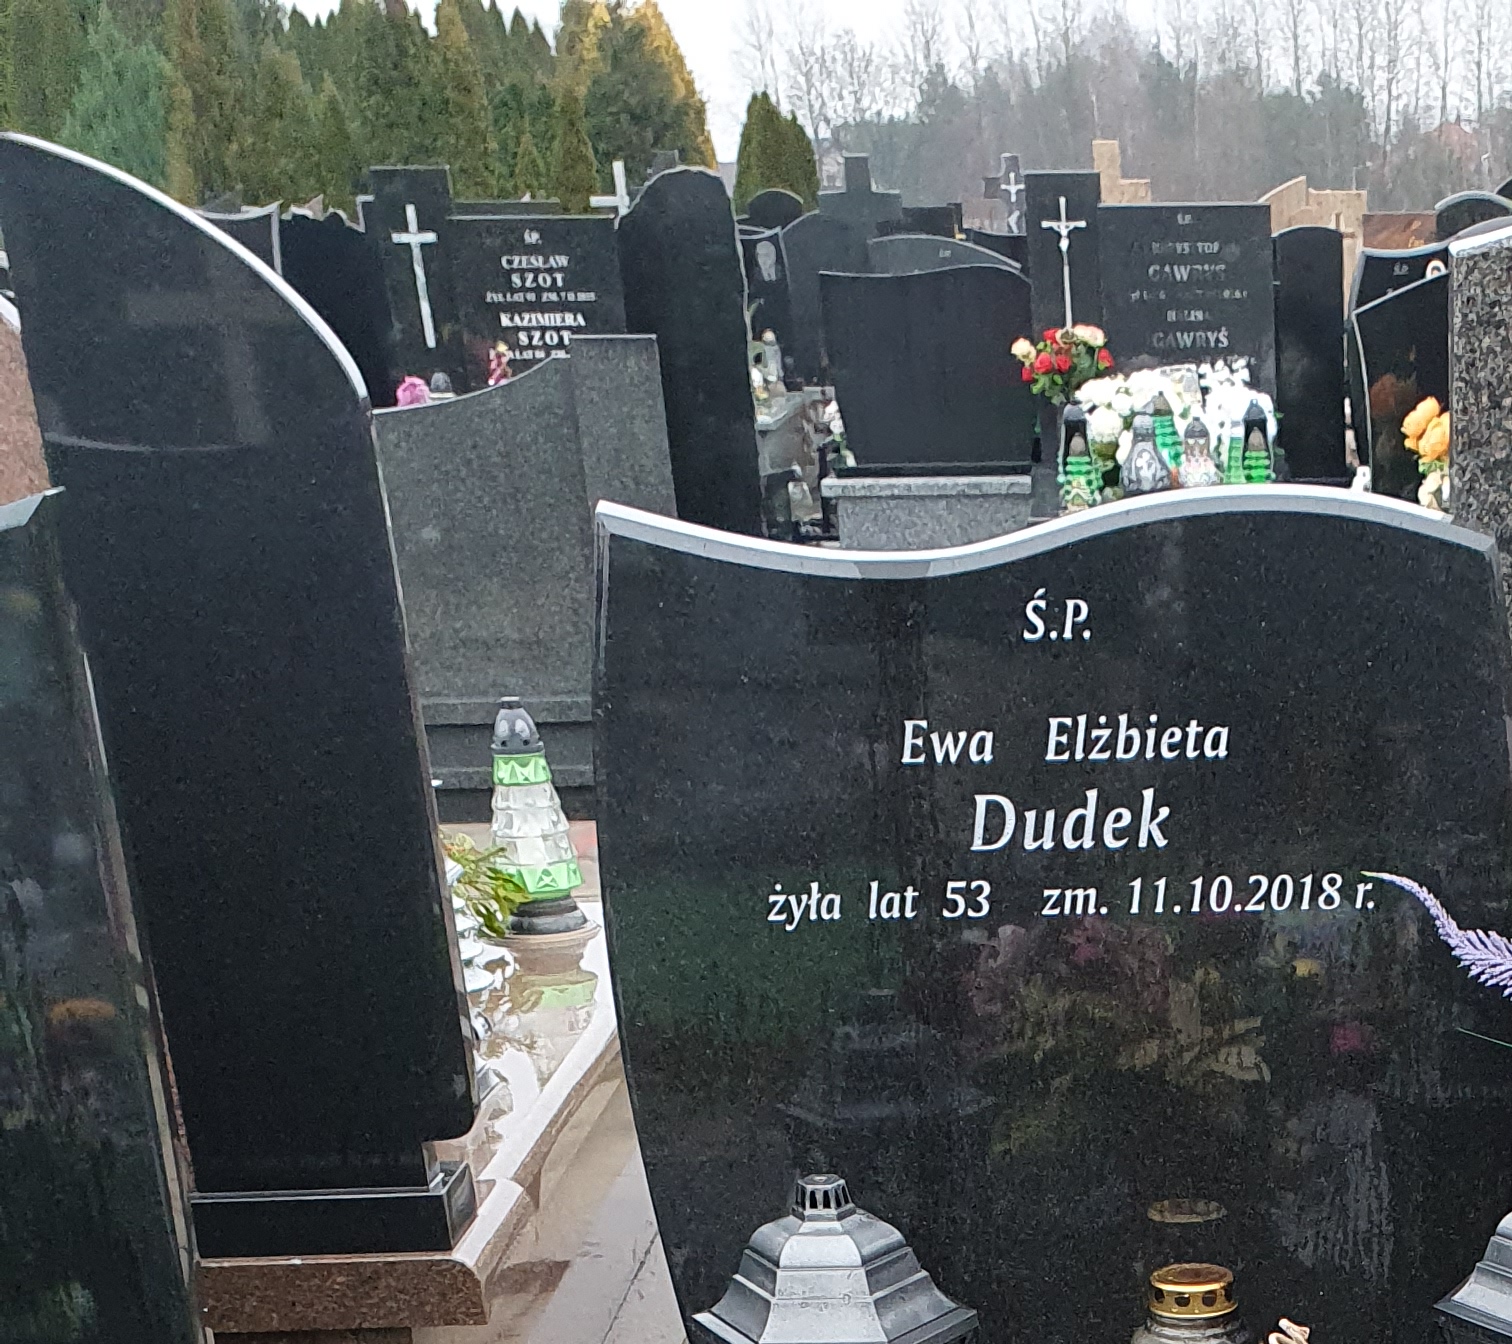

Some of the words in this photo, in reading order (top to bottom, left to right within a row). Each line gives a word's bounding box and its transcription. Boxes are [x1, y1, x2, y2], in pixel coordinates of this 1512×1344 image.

[511, 271, 565, 288] SZOT
[500, 311, 586, 327] KAZIMIERA
[518, 330, 572, 346] SZOT
[1022, 587, 1092, 641] Ś.P.
[900, 719, 994, 764] Ewa
[1044, 713, 1229, 762] Elżbieta
[969, 787, 1170, 851] Dudek
[767, 881, 842, 931] żyła
[868, 880, 920, 920] lat
[942, 880, 992, 918] 53
[1041, 886, 1108, 916] zm.
